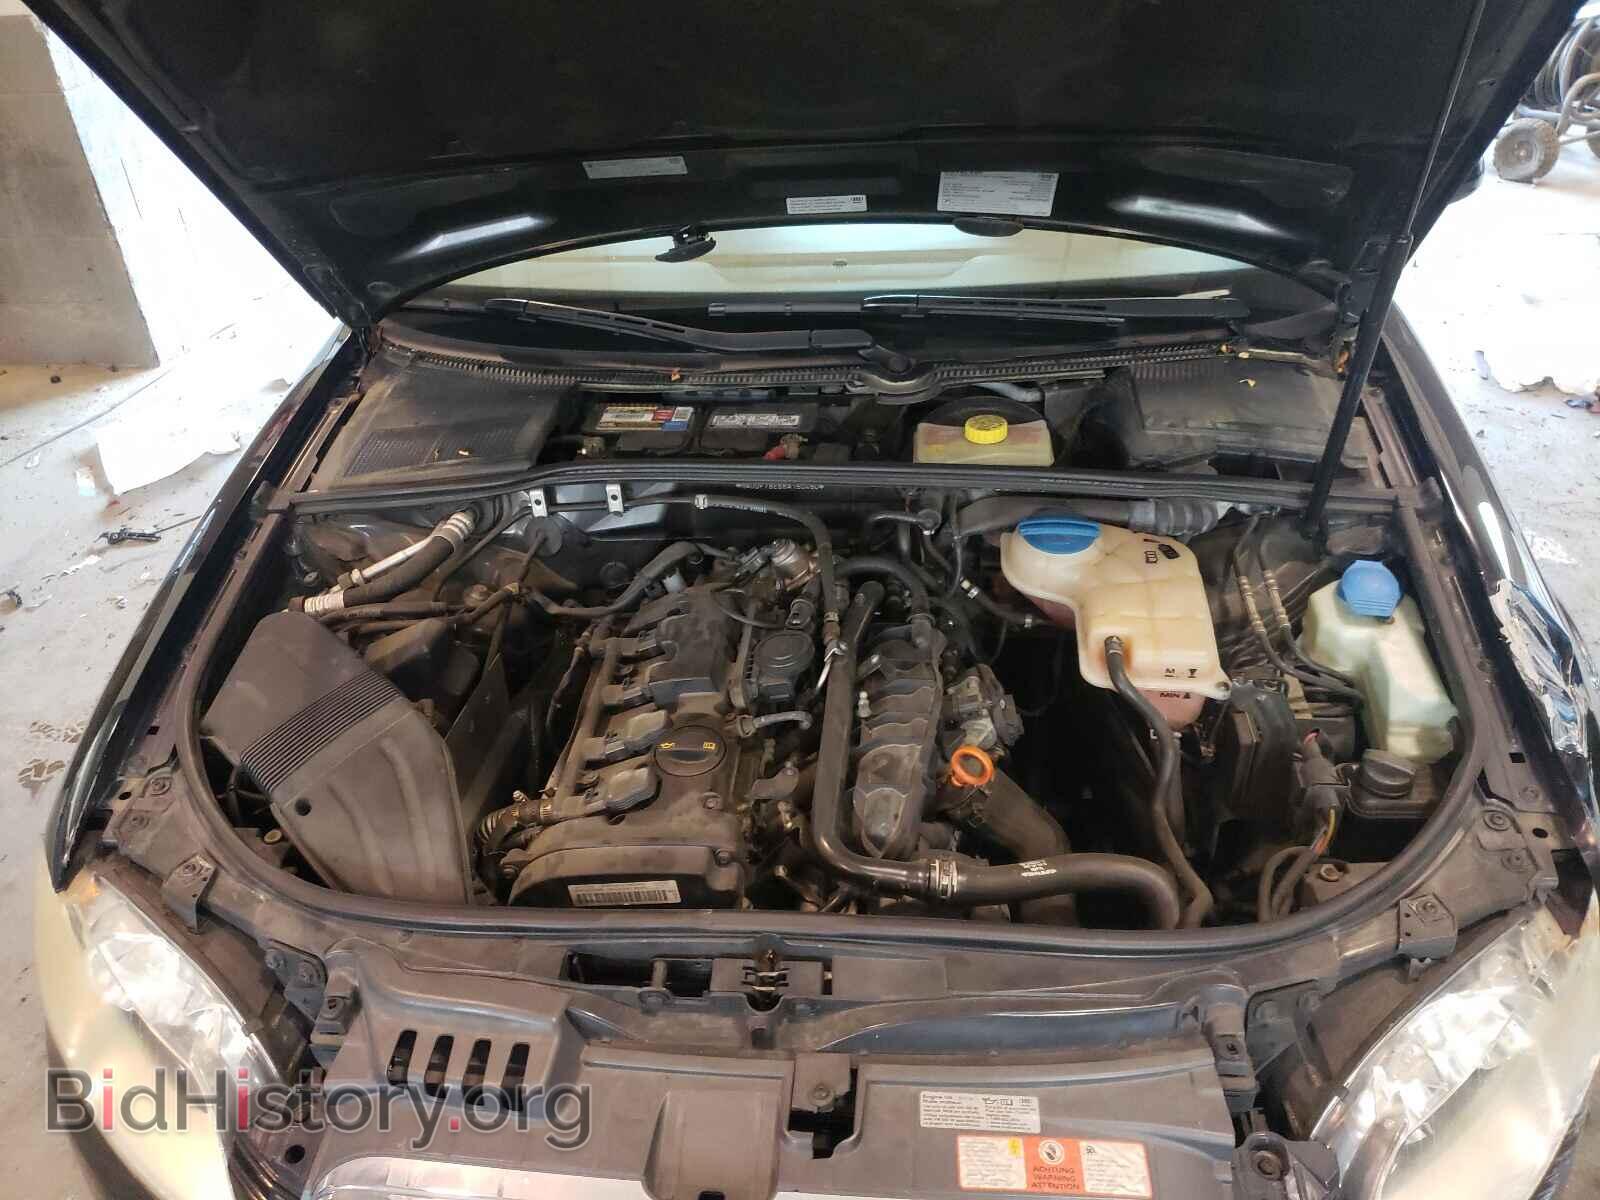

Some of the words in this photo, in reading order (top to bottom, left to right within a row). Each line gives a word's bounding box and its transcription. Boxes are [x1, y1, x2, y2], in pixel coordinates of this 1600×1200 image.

[1032, 1165, 1075, 1174] ACHTUNG
[1032, 1173, 1076, 1182] WARNING
[1031, 1181, 1080, 1190] ATTENTION
